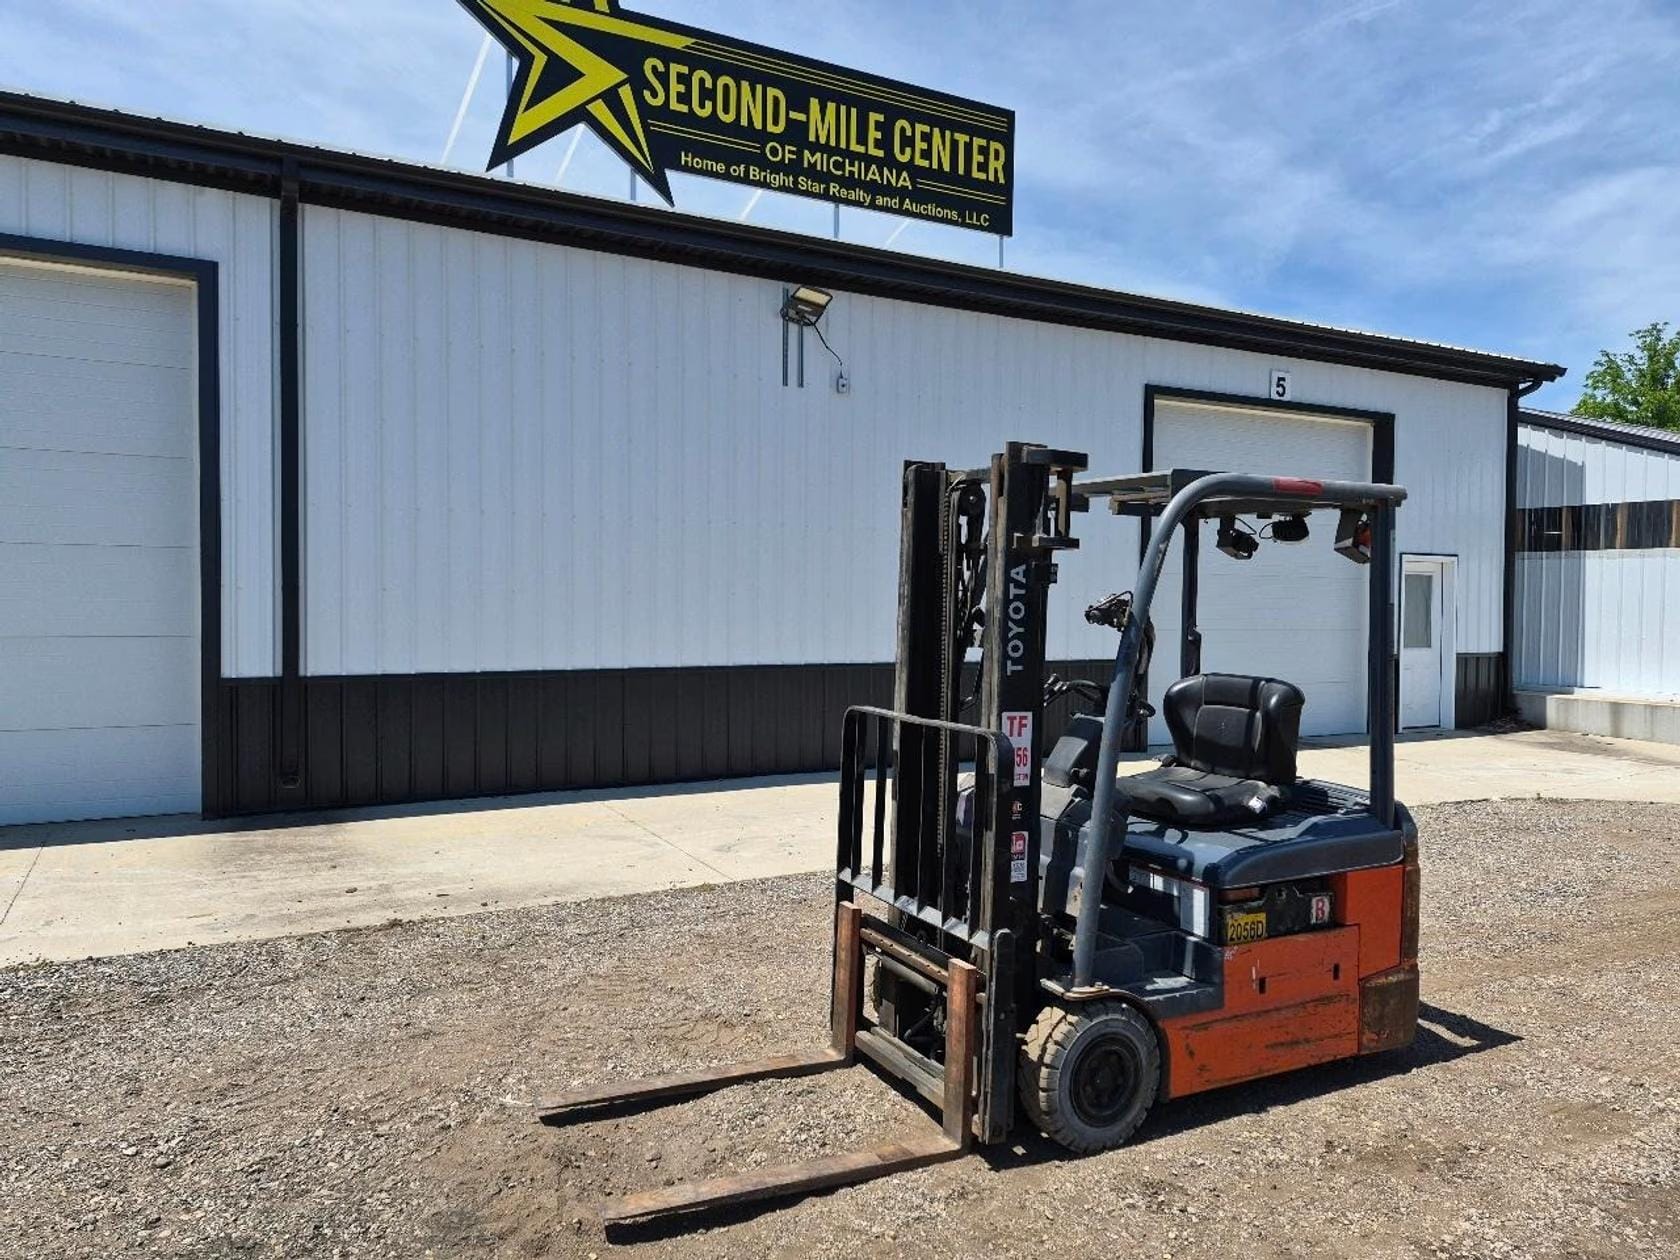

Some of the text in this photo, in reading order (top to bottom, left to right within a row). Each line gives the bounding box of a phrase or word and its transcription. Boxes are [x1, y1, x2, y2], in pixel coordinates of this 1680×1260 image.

[643, 57, 1006, 184] SECOND-MILE CENTER
[765, 141, 912, 190] OF MICHIANA
[681, 151, 990, 227] Home of Bright Star Realty and Auctions, LLC
[1275, 376, 1287, 398] 5
[1006, 564, 1026, 676] TOYOTA
[1007, 715, 1028, 738] TF
[1012, 747, 1029, 768] 56
[1315, 897, 1326, 922] B
[1229, 920, 1264, 941] 2056D
